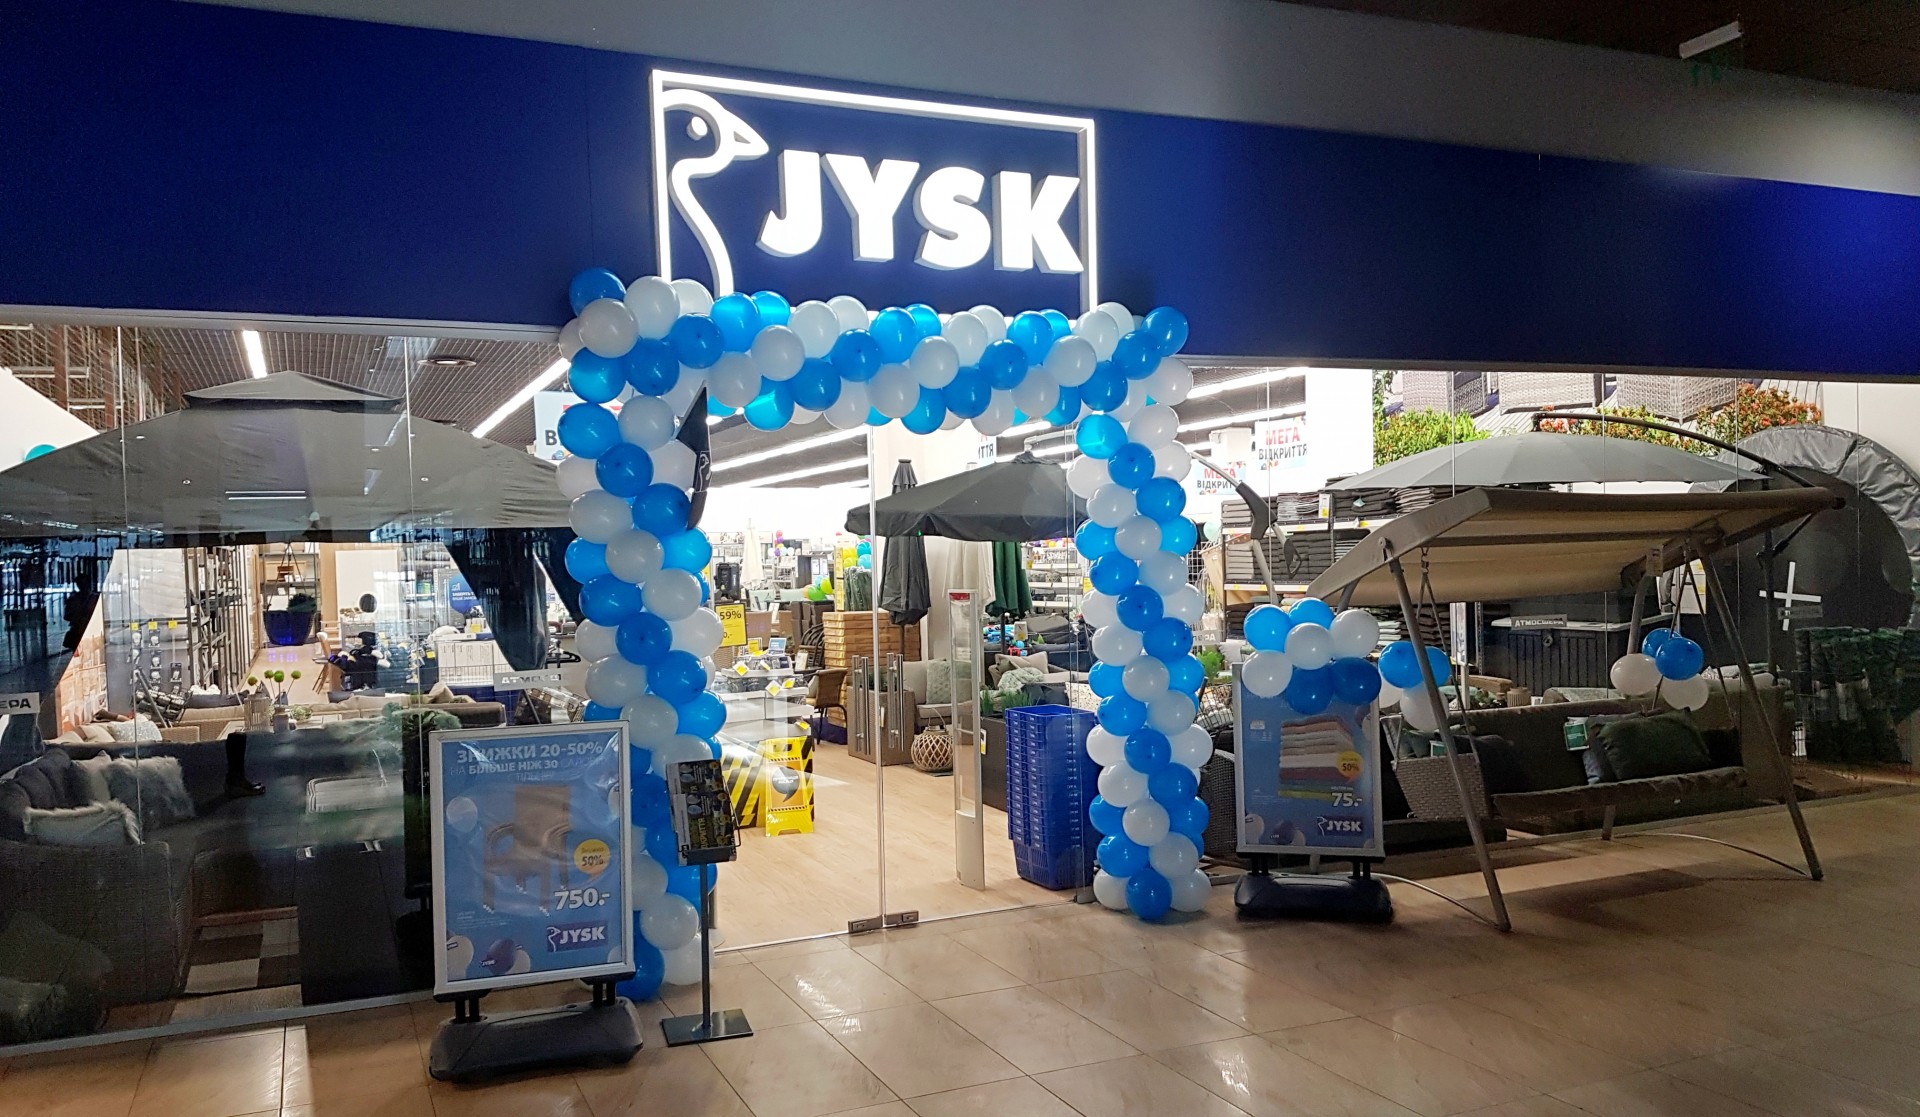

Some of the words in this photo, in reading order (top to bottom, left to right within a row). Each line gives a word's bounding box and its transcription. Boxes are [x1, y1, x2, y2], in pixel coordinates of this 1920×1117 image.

[756, 149, 1085, 274] JYSK
[545, 429, 558, 446] В
[1265, 427, 1300, 445] МЕГА
[1259, 443, 1308, 461] ВІДКРИТТЯ
[0, 699, 31, 709] ЕРА
[457, 746, 536, 764] ЗНИЖКИ
[540, 742, 603, 758] 20-50%
[468, 764, 516, 775] БІЛЬШЕ
[518, 761, 543, 771] НІЖ
[544, 760, 558, 769] 30
[1331, 792, 1362, 807] 75.-
[1327, 821, 1362, 832] JYSK
[582, 855, 604, 866] 50%
[555, 888, 610, 911] 750.-
[560, 926, 605, 944] JYSK
